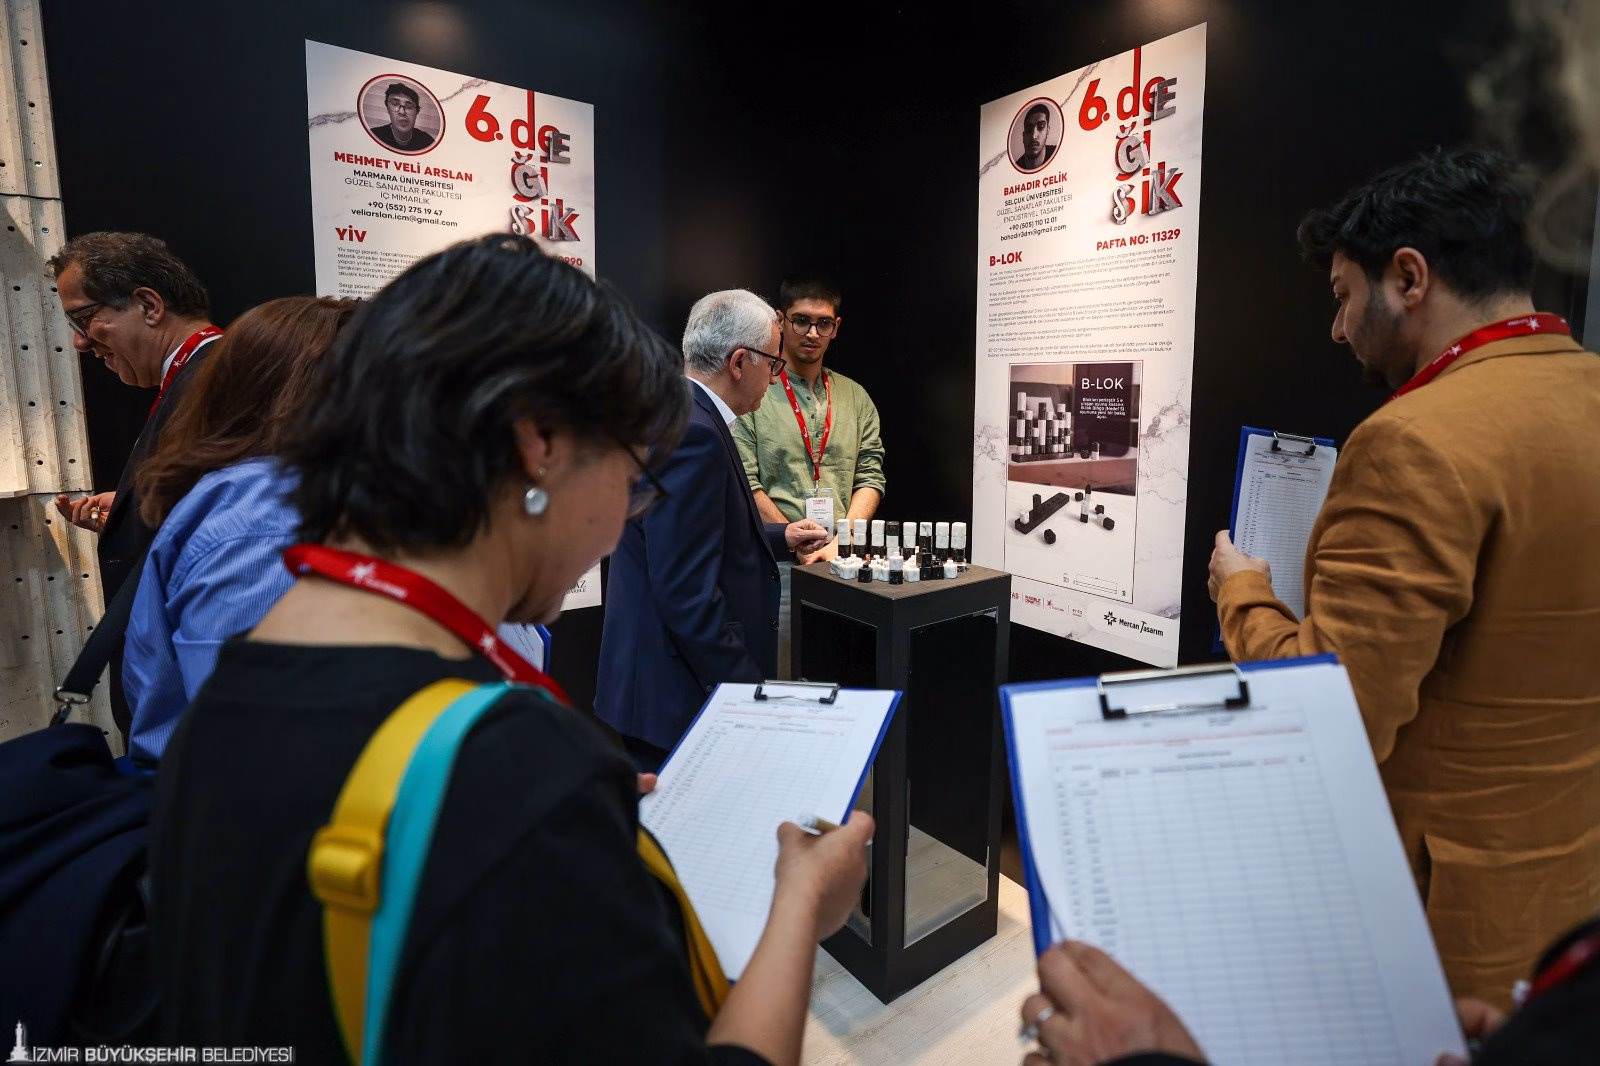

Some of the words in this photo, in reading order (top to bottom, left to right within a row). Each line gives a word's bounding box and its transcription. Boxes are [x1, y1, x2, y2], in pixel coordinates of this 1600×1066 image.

[334, 152, 390, 169] MEHMET
[394, 161, 421, 174] VELİ
[424, 166, 473, 182] ARSLAN
[345, 177, 374, 188] GÜZEL
[376, 182, 419, 194] SANATLAR
[422, 188, 462, 200] FAKÜLTESİ
[354, 170, 398, 182] MARMARA
[400, 174, 454, 190] ÜNİVERSİTESİ
[1004, 180, 1041, 196] BAHADIR
[1042, 172, 1068, 188] ÇELİK
[391, 194, 430, 204] MİMARLIK
[1005, 196, 1025, 206] SELÇUK
[1026, 186, 1064, 201] ÜNİVERSİTESİ
[1015, 201, 1042, 213] SANATLAR
[1044, 194, 1073, 205] FAKÜLTESİ
[351, 208, 458, 227] veliarslan.icm@gmail.com
[386, 203, 407, 213] (552)
[408, 206, 422, 214] 275
[1003, 212, 1038, 223] ENDÜSTRİYEL
[1040, 206, 1064, 216] TASARIM
[1096, 238, 1127, 251] PAFTA
[1130, 234, 1149, 246] NO:
[1152, 228, 1180, 243] 11329
[990, 251, 1022, 266] B-LOK
[1082, 378, 1124, 389] B-LOK
[1119, 618, 1139, 630] Mercan
[1140, 620, 1164, 636] Tasarım
